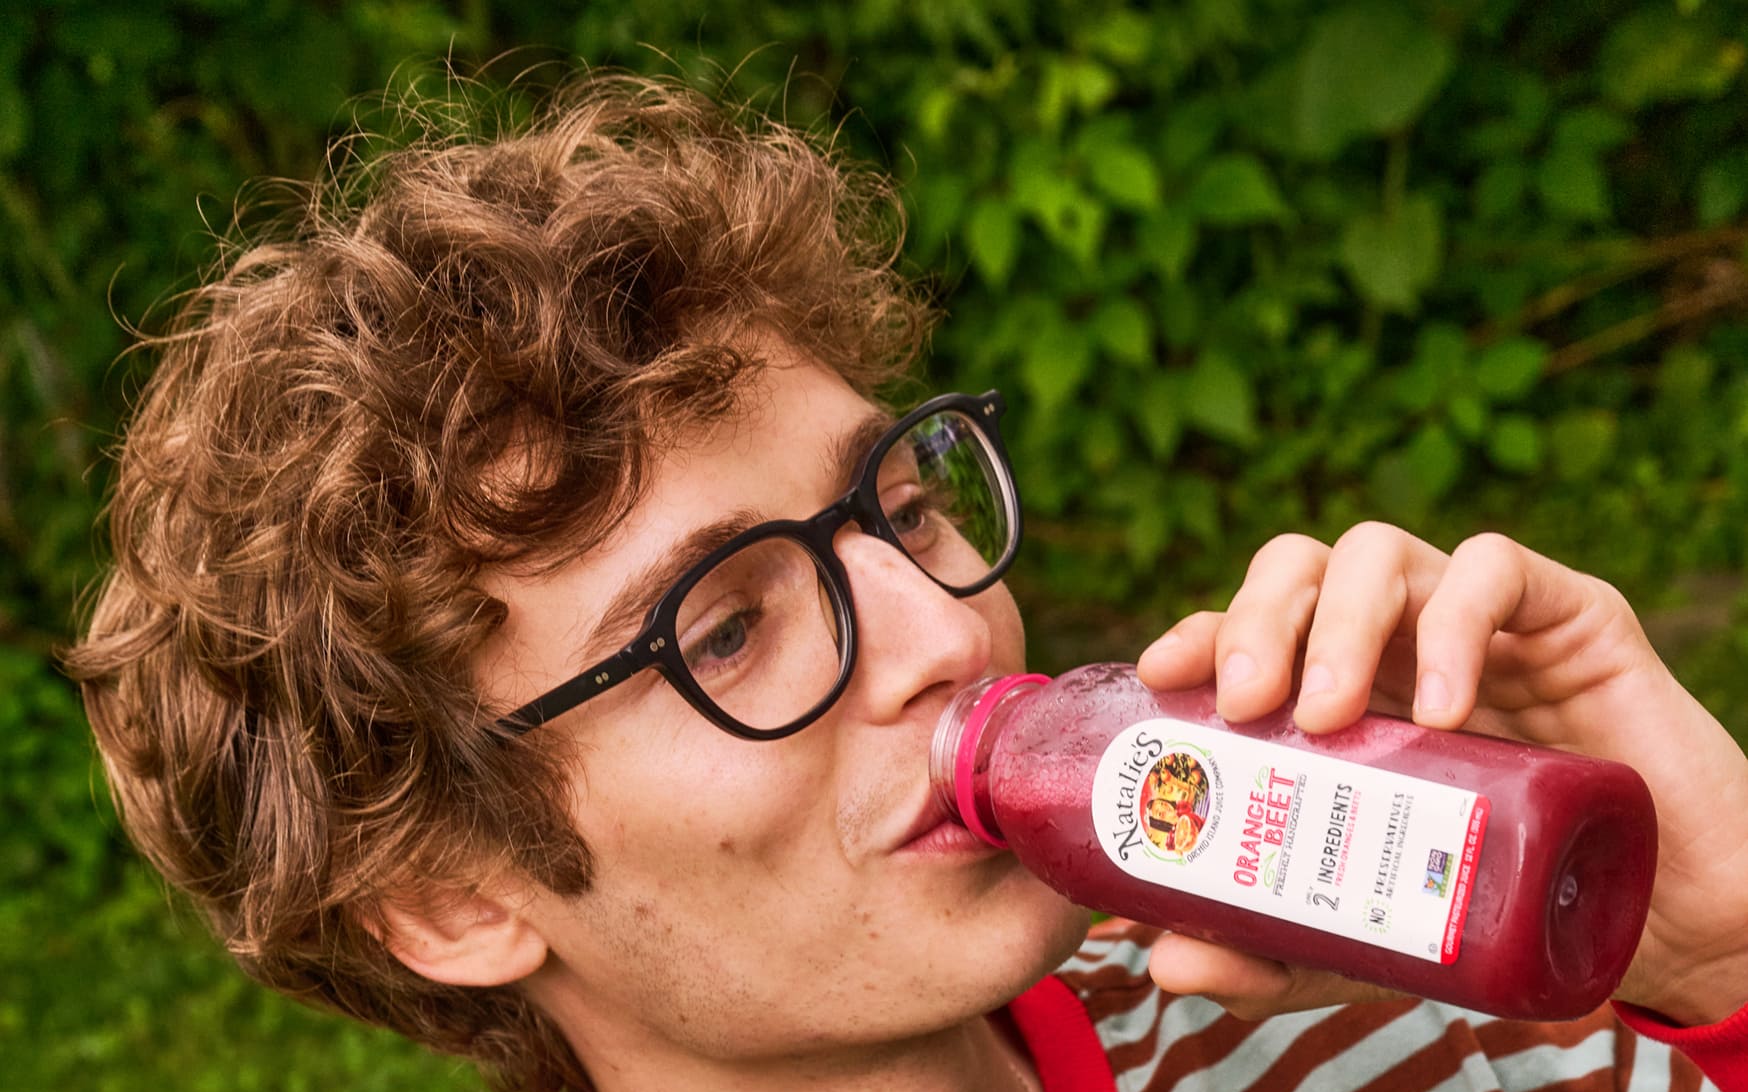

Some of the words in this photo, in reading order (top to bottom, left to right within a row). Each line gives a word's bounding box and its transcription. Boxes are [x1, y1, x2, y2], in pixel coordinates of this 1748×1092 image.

[1113, 732, 1163, 862] Natalie'S
[1209, 757, 1223, 788] COMPANY
[1215, 792, 1224, 813] JUICE
[1264, 767, 1295, 845] BEET
[1186, 840, 1210, 863] ORCHID
[1206, 814, 1220, 841] ISLAND
[1234, 791, 1265, 887] ORANGE
[1275, 851, 1291, 897] FRESHLY
[1285, 774, 1308, 849] HANDCRAFTED
[1317, 783, 1353, 885] INGREDIENTS
[1334, 863, 1346, 887] FRESH
[1340, 822, 1355, 861] ORANGES
[1350, 789, 1362, 815] BEETS
[1374, 792, 1404, 895] PRESERVATIVES
[1396, 794, 1414, 848] INGREDIENTS
[1312, 892, 1339, 911] 2
[1370, 907, 1386, 925] NO
[1445, 923, 1457, 954] GOURMET
[1451, 882, 1467, 924] PASTEURIZED
[1461, 864, 1471, 884] JUICE
